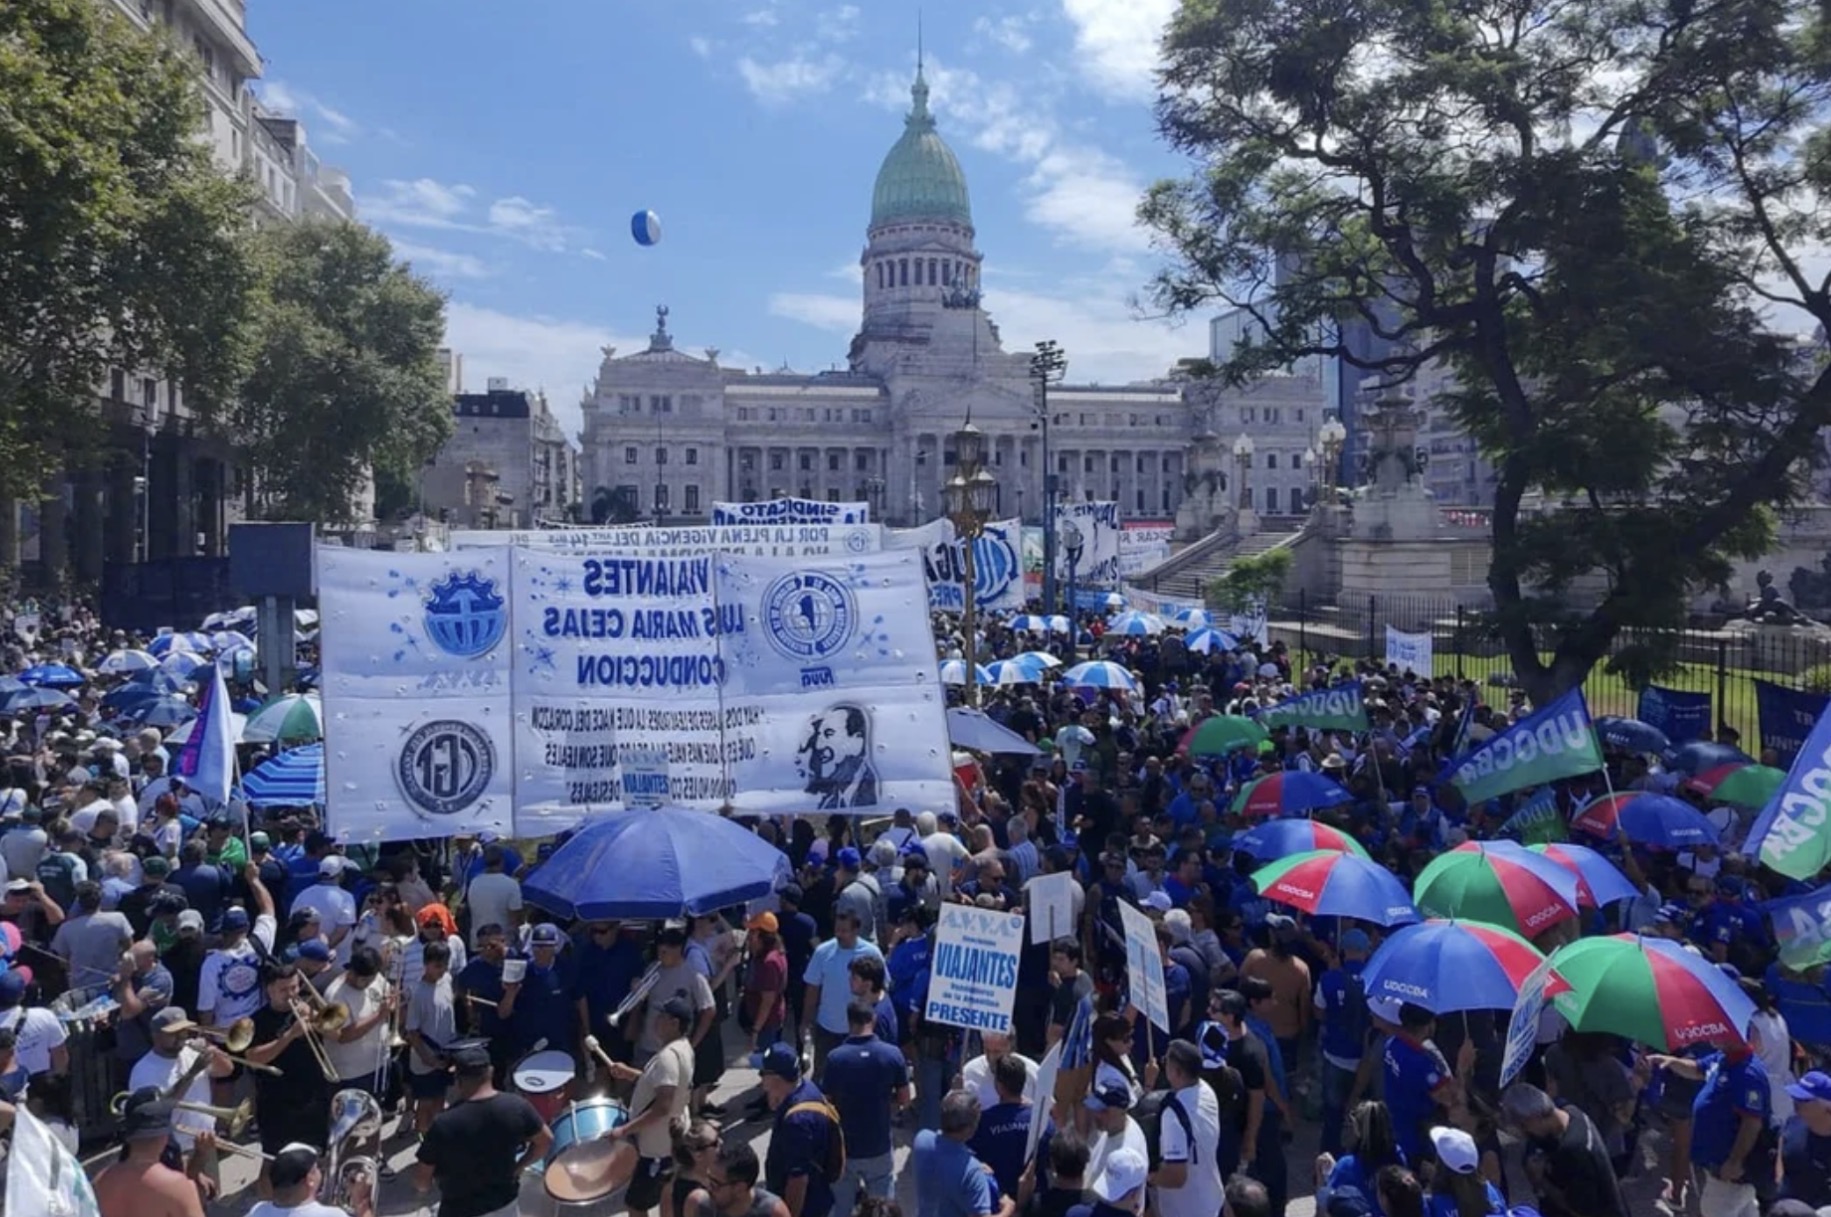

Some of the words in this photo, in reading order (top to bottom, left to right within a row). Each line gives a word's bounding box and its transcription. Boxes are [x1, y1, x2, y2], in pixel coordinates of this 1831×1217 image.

[1278, 883, 1314, 899] UDOCBA
[1526, 903, 1563, 928] UDOCBA
[936, 941, 1018, 990] VIAJANTES
[1384, 978, 1428, 1000] UDOCBA
[928, 1001, 1009, 1032] PRESENTE
